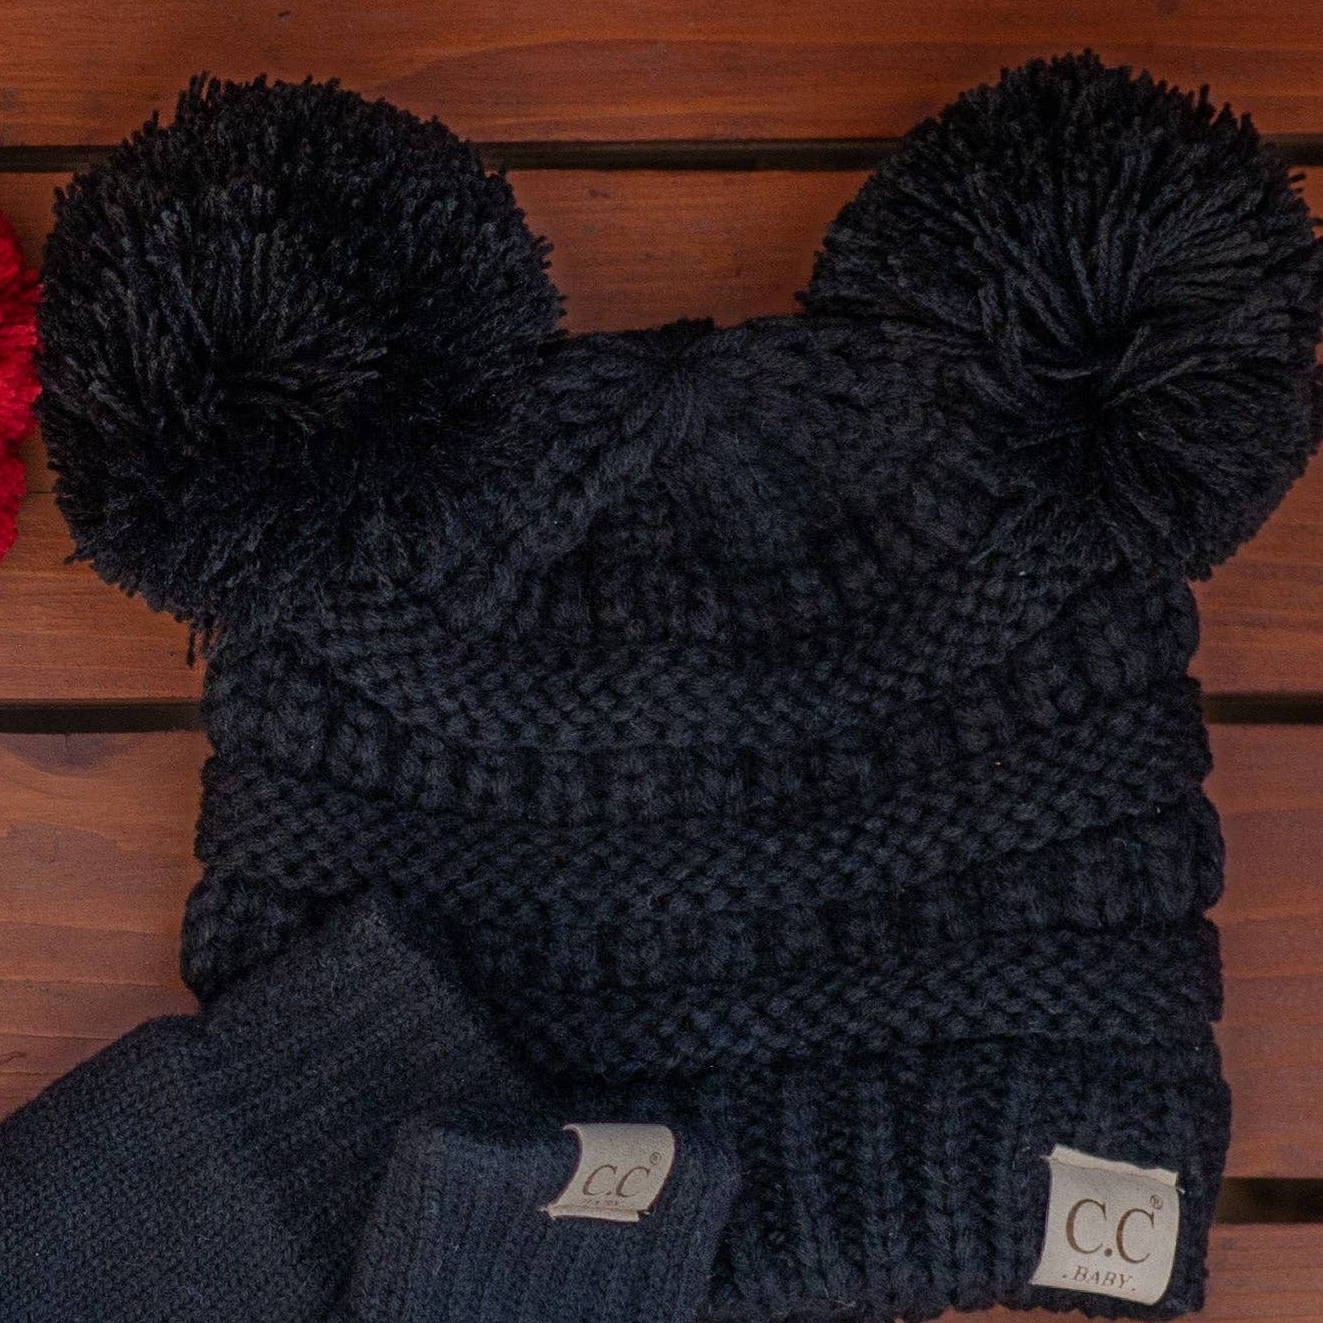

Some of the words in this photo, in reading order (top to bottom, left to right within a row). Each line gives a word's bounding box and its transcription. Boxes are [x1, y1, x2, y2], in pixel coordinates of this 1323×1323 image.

[582, 1164, 652, 1198] C.C
[1065, 1198, 1155, 1264] C.C
[1072, 1265, 1132, 1289] BABY
